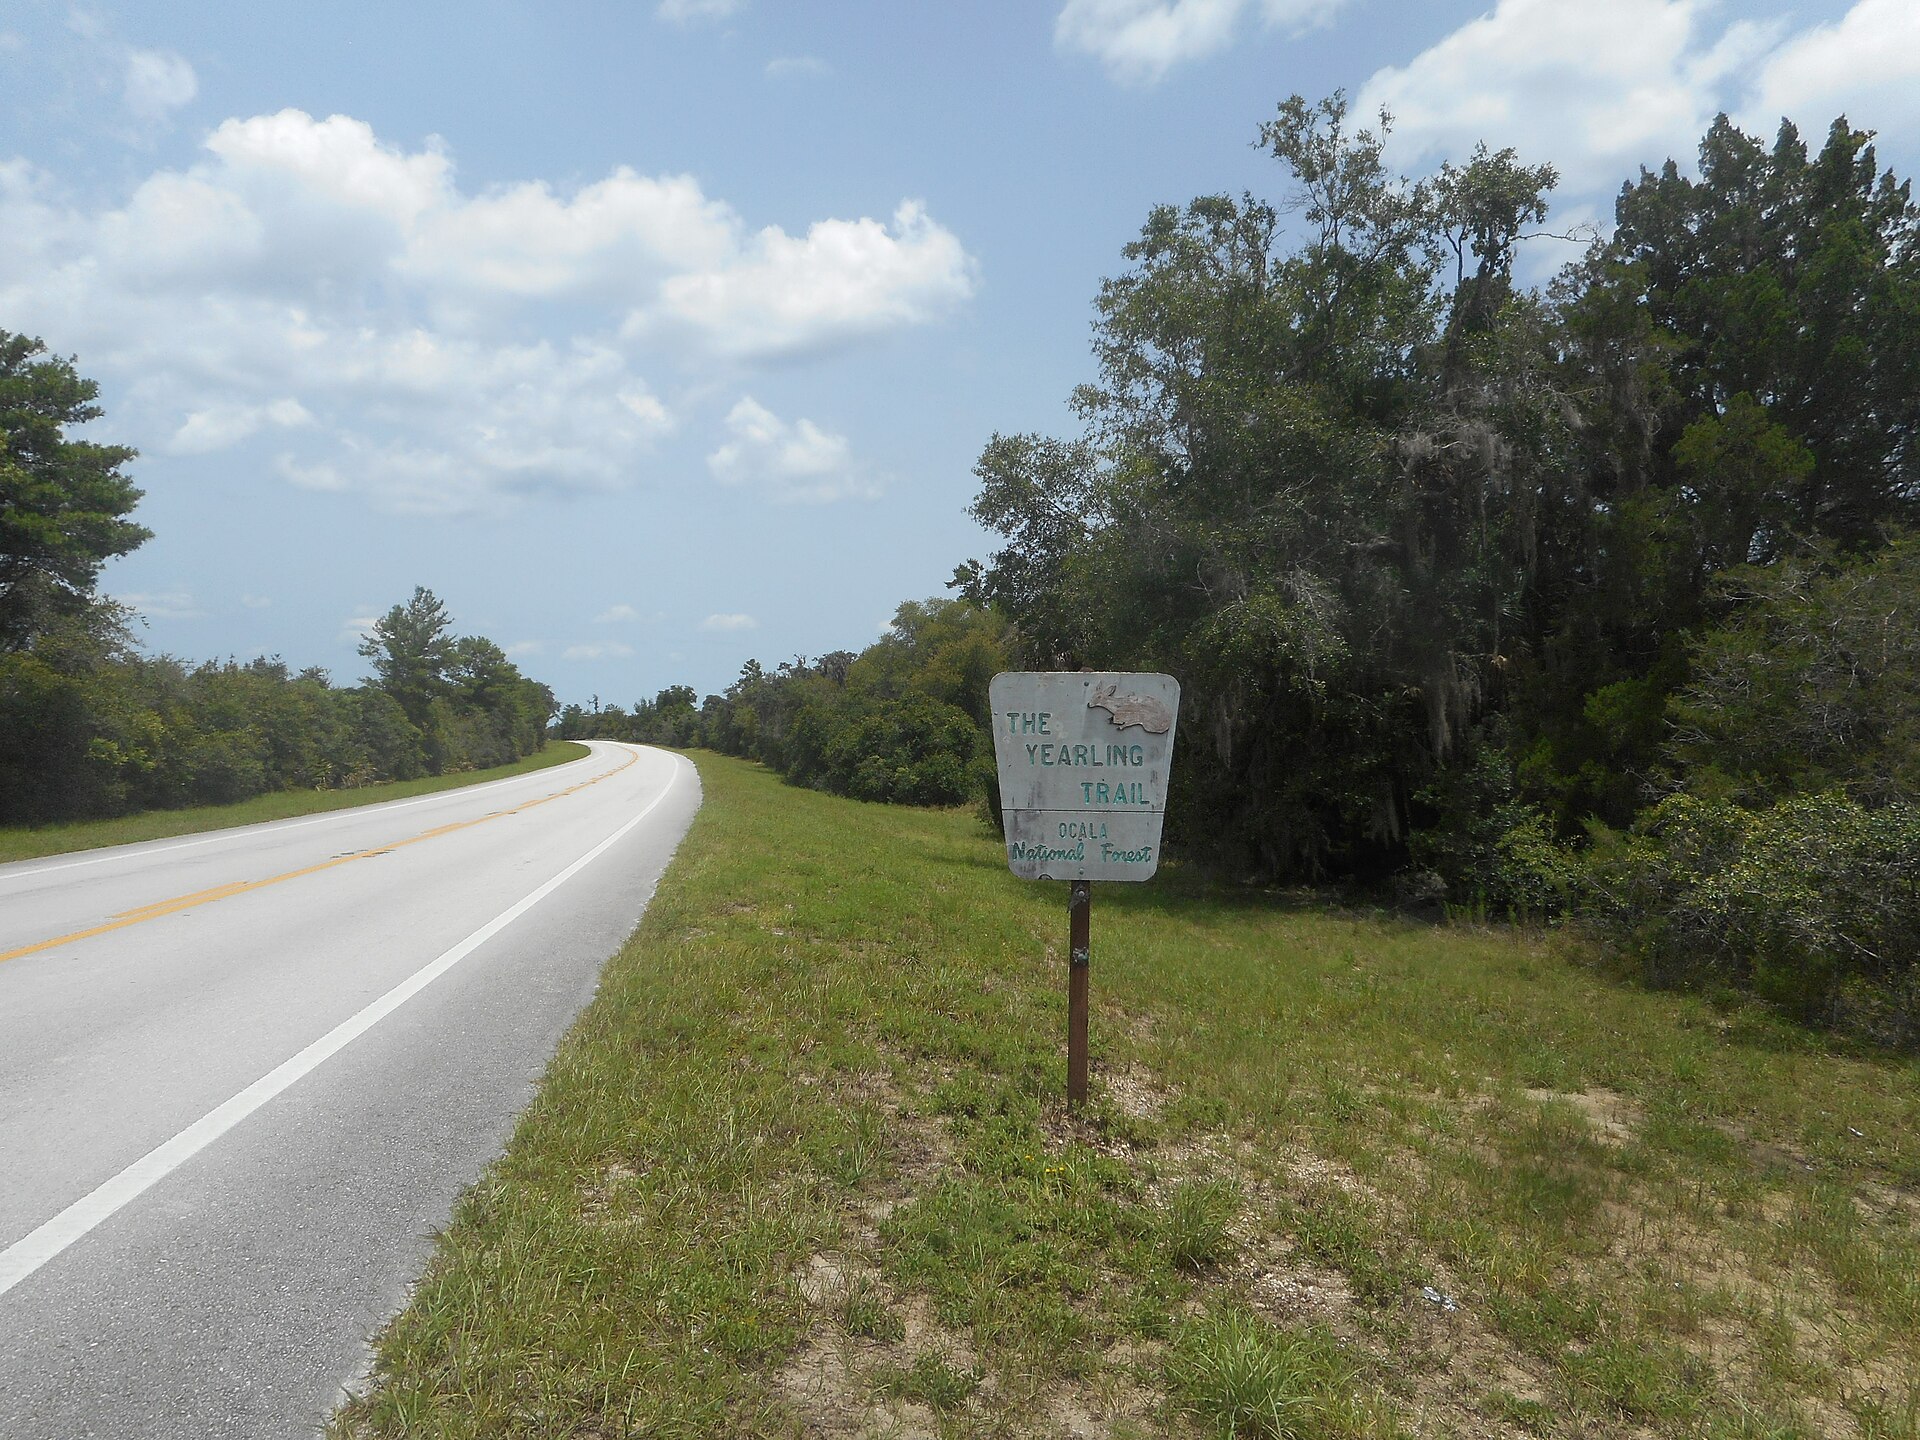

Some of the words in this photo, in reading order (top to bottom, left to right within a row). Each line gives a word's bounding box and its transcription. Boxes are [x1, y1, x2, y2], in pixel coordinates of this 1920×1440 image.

[1006, 712, 1052, 735] THE
[1025, 743, 1144, 767] YEARLING
[1080, 782, 1150, 805] TRAIL
[1058, 822, 1108, 839] OCALA
[1012, 841, 1085, 862] National
[1100, 843, 1153, 863] Forest
